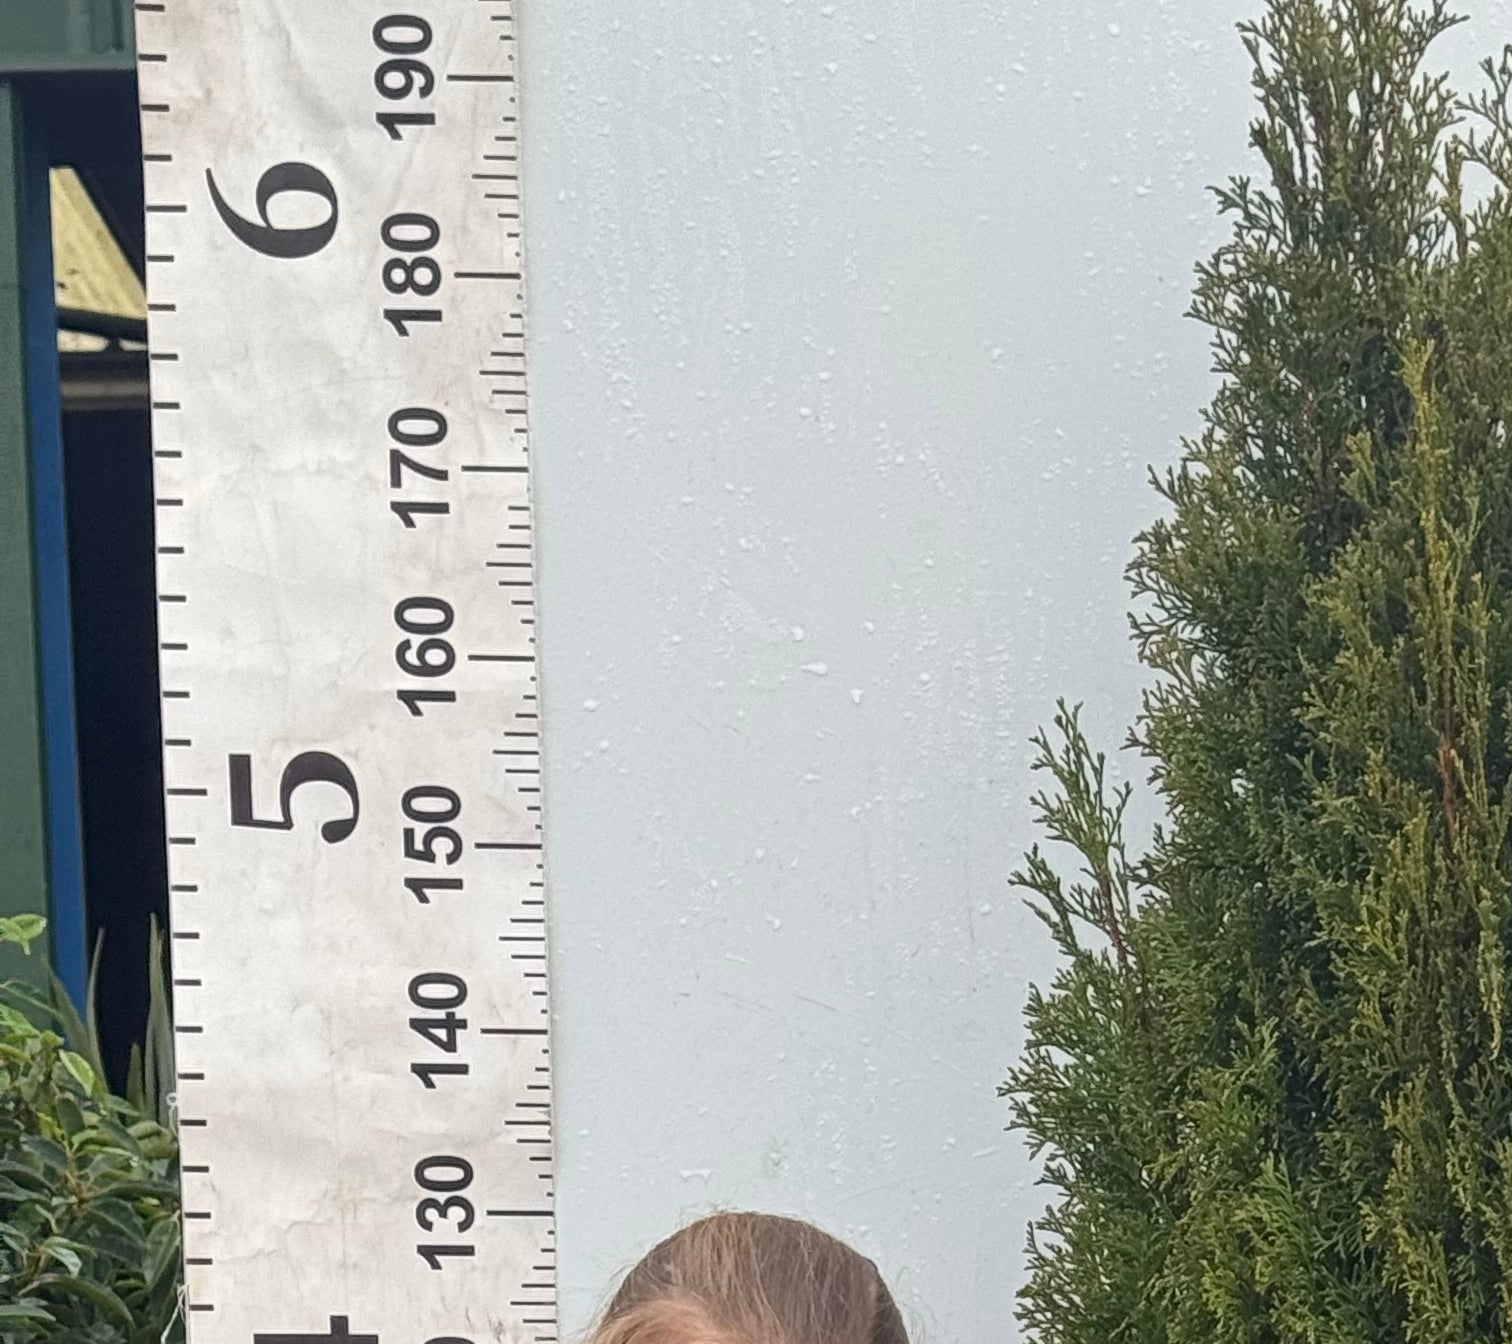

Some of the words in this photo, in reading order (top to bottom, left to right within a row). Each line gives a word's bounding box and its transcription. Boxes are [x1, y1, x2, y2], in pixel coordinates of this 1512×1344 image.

[373, 15, 435, 139] 190
[207, 163, 338, 258] 6
[381, 213, 442, 336] 180
[388, 408, 449, 527] 170
[395, 597, 456, 716] 160
[230, 752, 359, 843] 5
[402, 786, 463, 903] 150
[409, 973, 468, 1088] 140
[415, 1156, 474, 1269] 130
